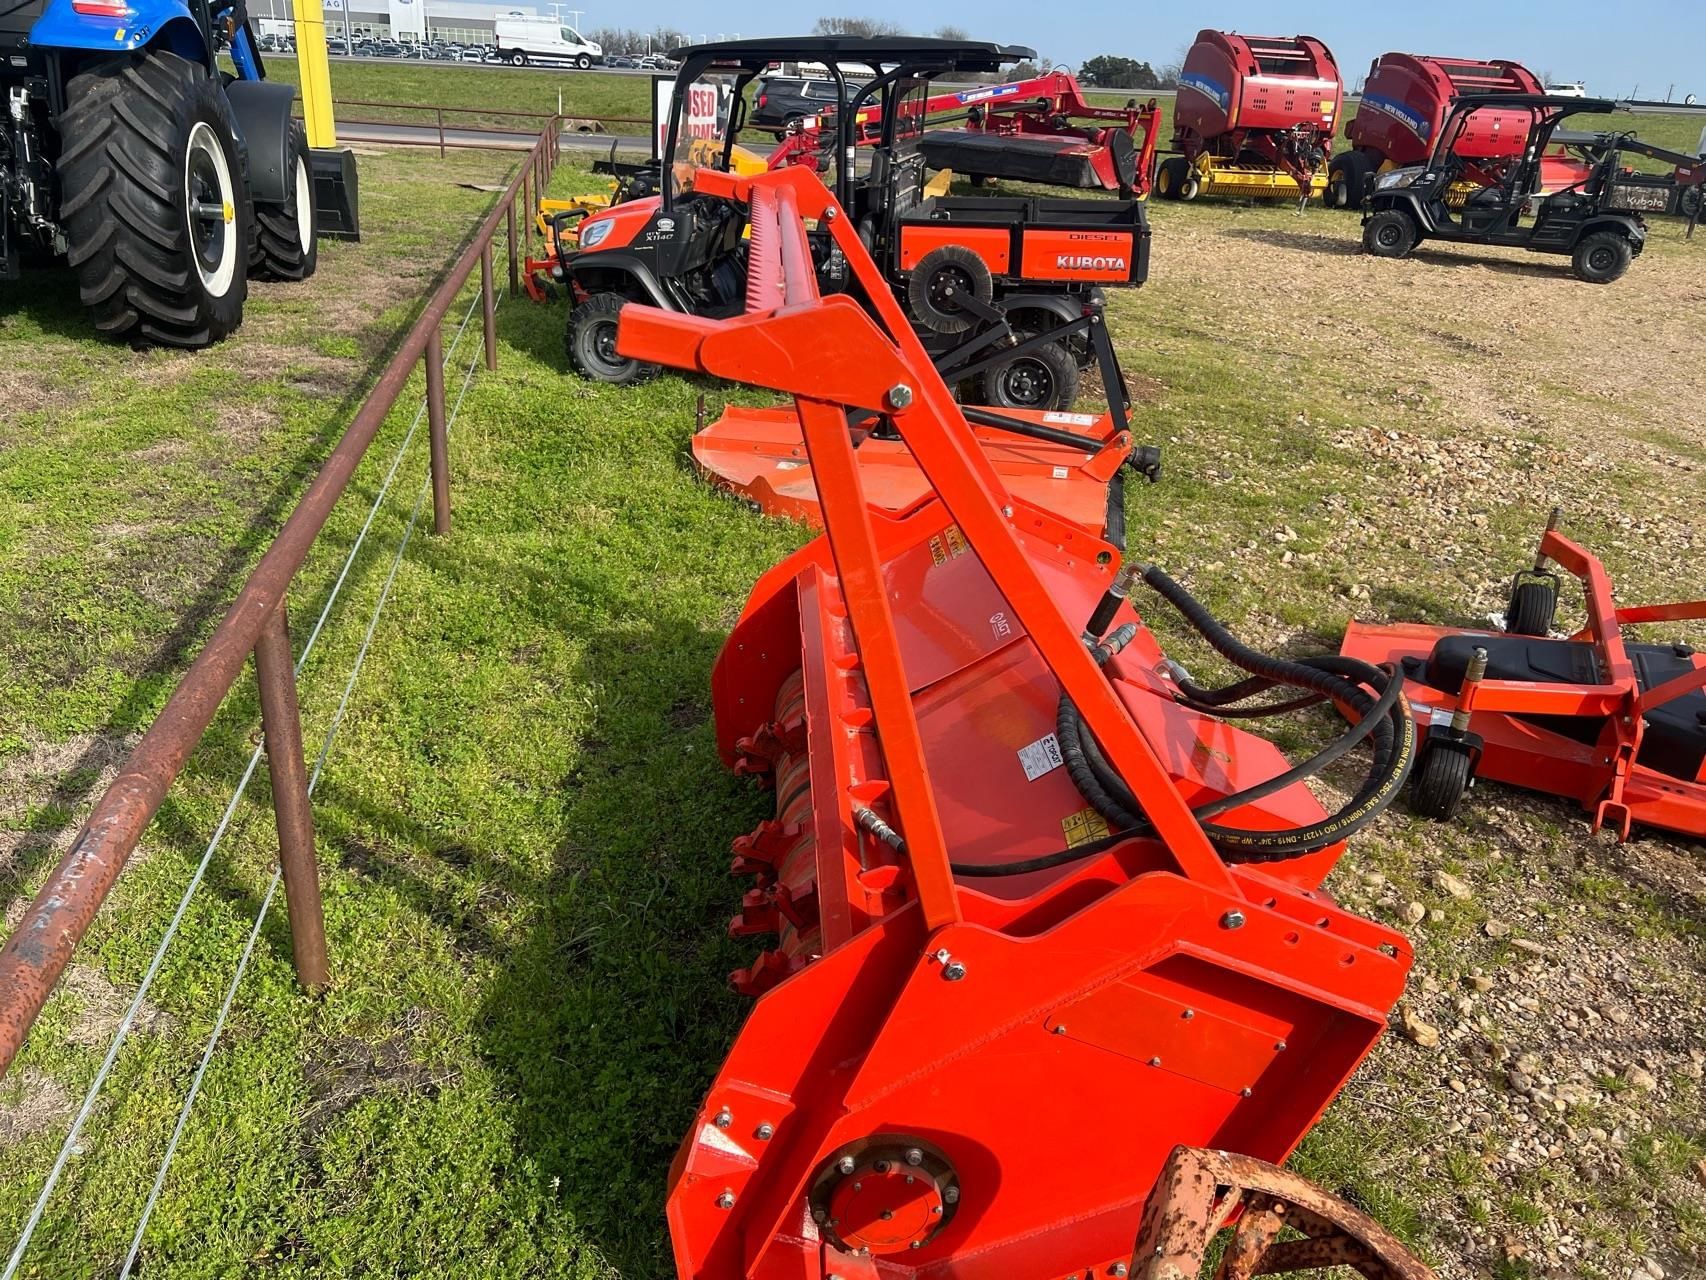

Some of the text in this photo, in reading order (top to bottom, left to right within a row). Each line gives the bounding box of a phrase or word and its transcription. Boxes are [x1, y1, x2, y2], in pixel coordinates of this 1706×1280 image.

[1384, 103, 1397, 115] NEW
[1395, 108, 1418, 130] HOLLAND
[1069, 234, 1124, 242] DIESEL
[1056, 255, 1126, 271] KUBOTA
[1047, 743, 1062, 764] TOPCAT
[1364, 796, 1379, 811] SAE
[1303, 829, 1324, 841] 11237
[1324, 823, 1338, 835] ISO
